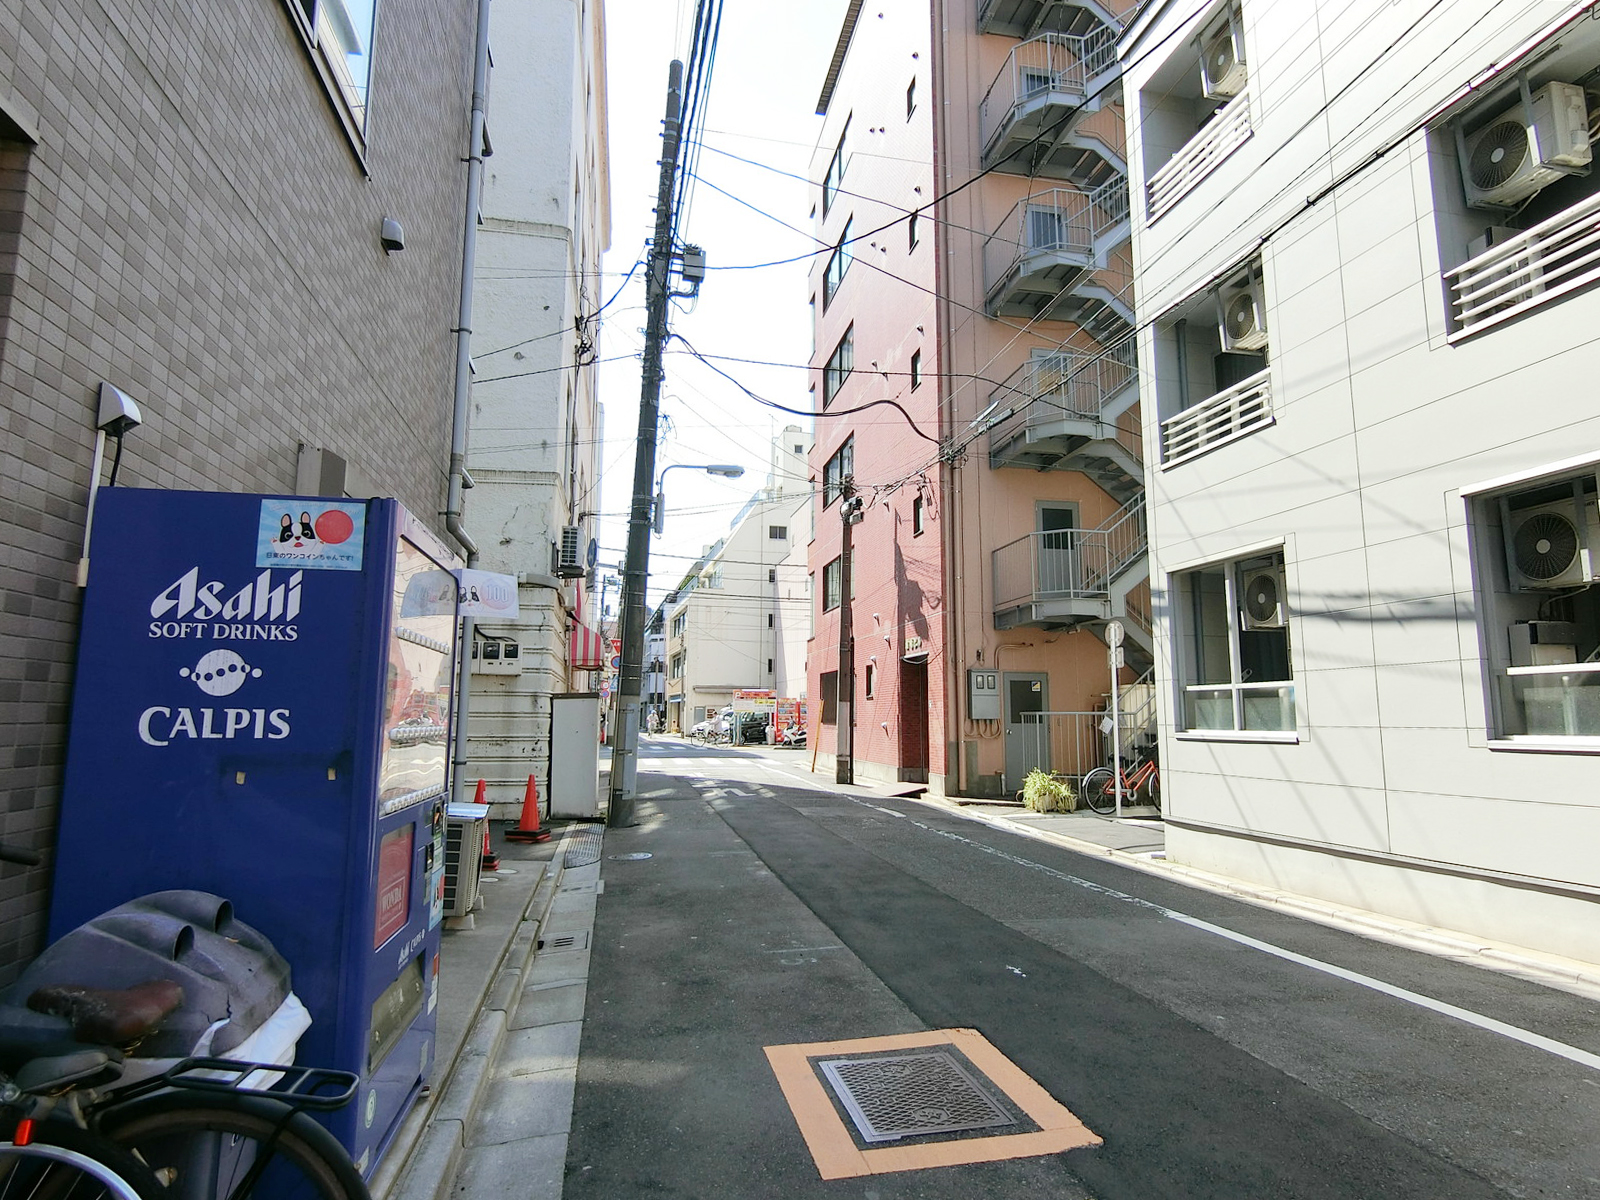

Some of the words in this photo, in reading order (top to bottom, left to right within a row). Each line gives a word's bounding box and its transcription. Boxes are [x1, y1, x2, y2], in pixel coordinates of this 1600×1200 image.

[150, 567, 302, 622] Asahi
[486, 584, 509, 602] 100
[148, 623, 206, 638] SOFT
[211, 624, 298, 641] DRINKS
[138, 706, 290, 745] CALPIS
